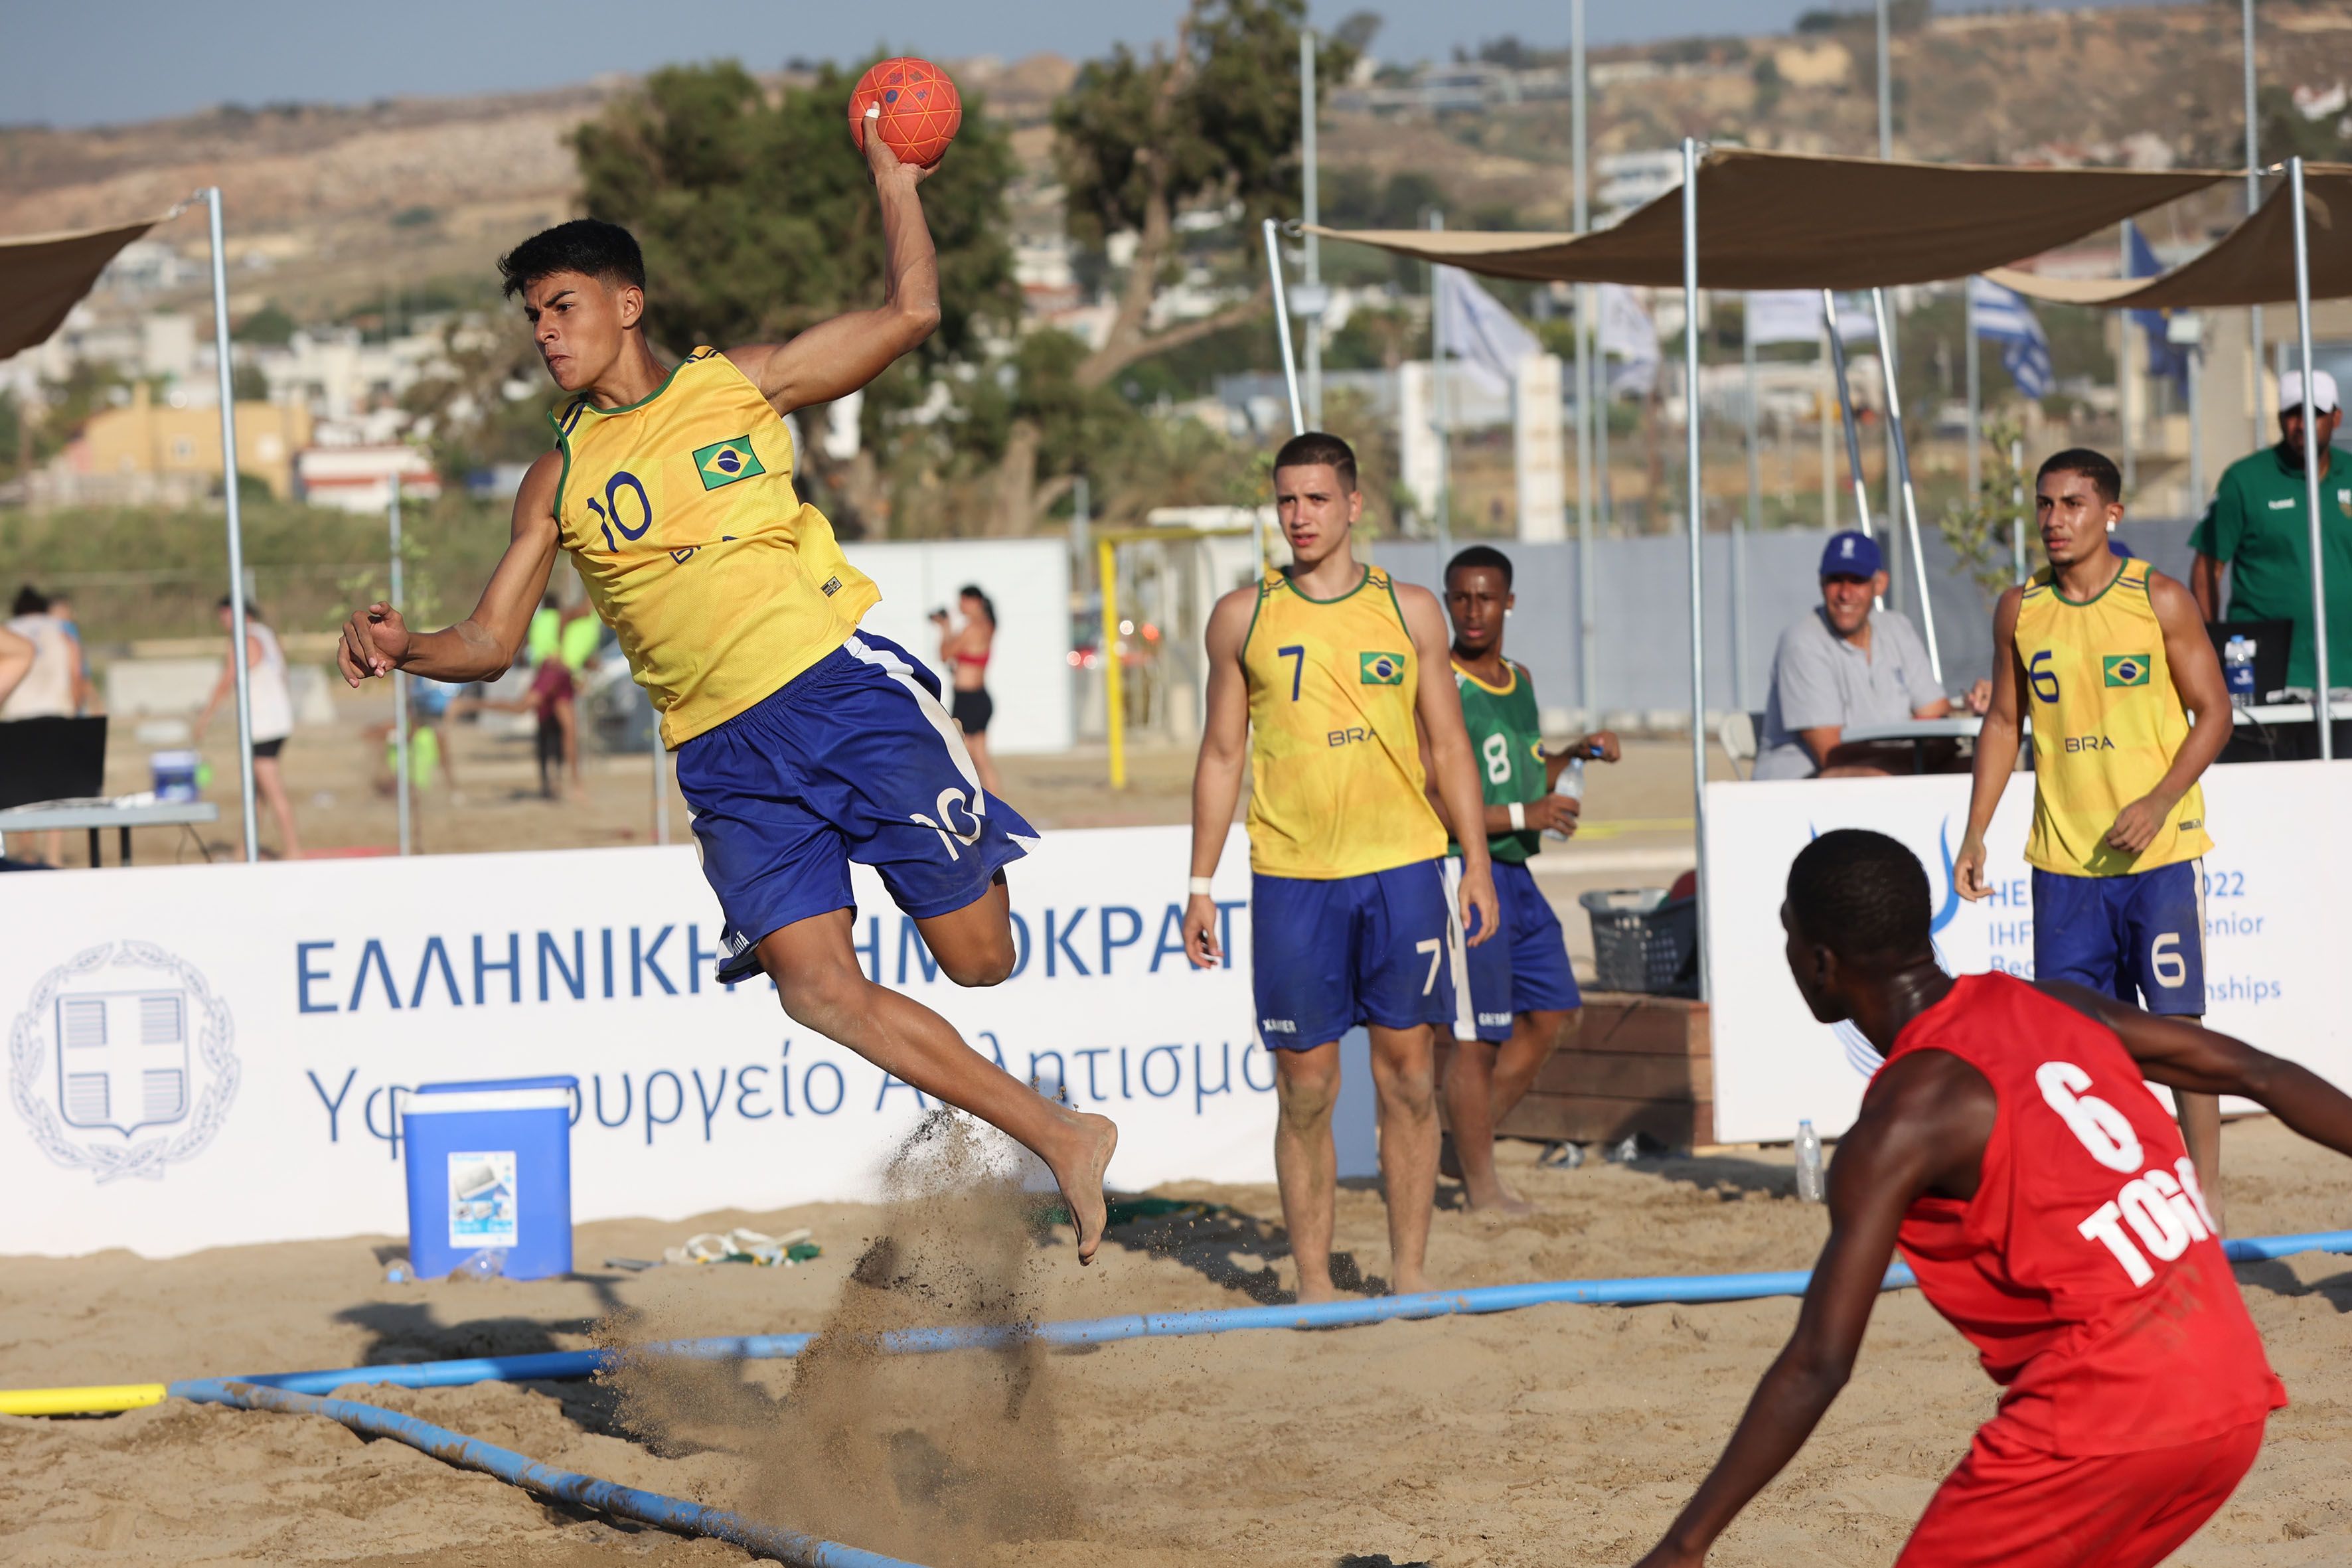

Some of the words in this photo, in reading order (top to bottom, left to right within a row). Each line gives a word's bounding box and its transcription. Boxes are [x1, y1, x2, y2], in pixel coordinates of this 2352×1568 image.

[587, 471, 652, 553] 10
[1278, 645, 1304, 702] 7
[2029, 650, 2059, 702] 6
[1482, 732, 1511, 785] 8
[2065, 736, 2115, 753] BRA
[1989, 920, 2034, 945] IHF
[2152, 932, 2186, 988] 6
[1416, 937, 1441, 996] 7
[306, 1039, 844, 1161] Υφυργείο
[2035, 1061, 2145, 1174] 6
